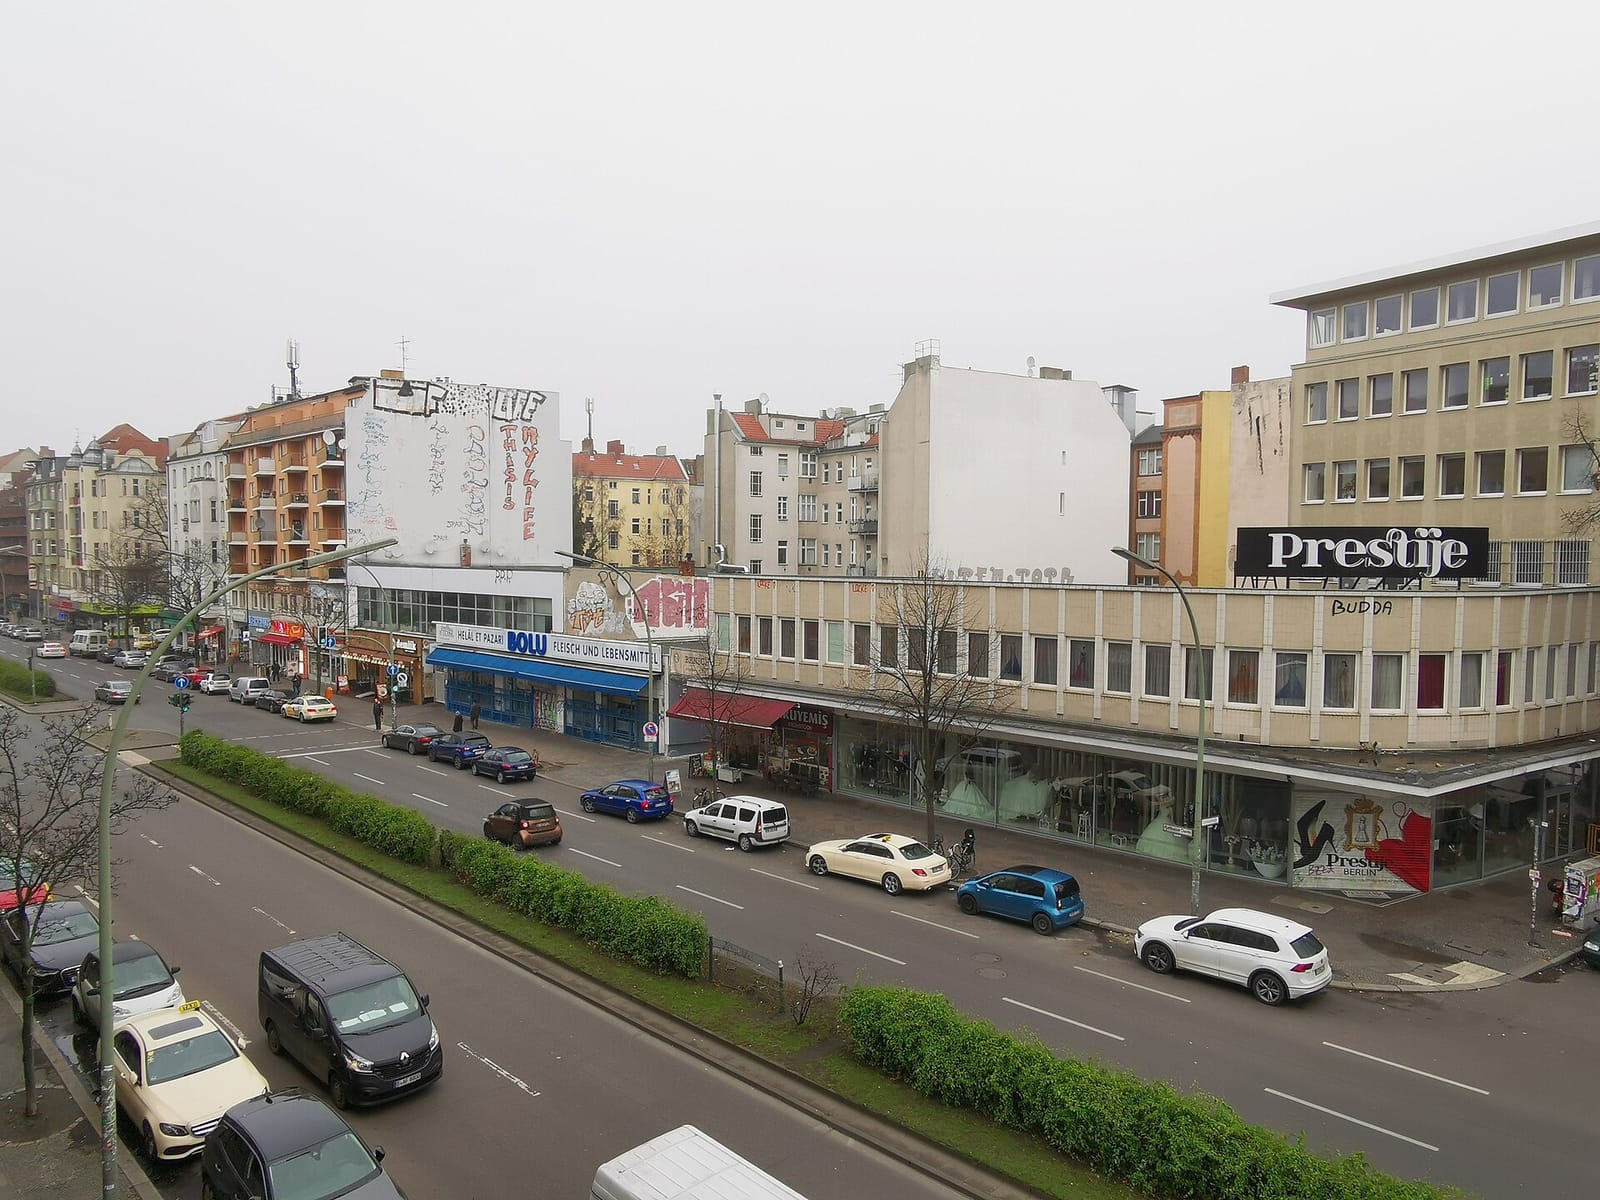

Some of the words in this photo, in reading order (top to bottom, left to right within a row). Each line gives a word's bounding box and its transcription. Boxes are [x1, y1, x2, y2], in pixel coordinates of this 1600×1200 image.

[1267, 527, 1469, 578] Prestije
[1332, 600, 1393, 616] BUDDA
[475, 632, 482, 642] ET
[507, 631, 547, 656] BOLU
[553, 641, 580, 655] FLEISCH
[582, 645, 599, 657] UND
[1343, 868, 1377, 877] BERLIN
[182, 1002, 199, 1011] TAXI
